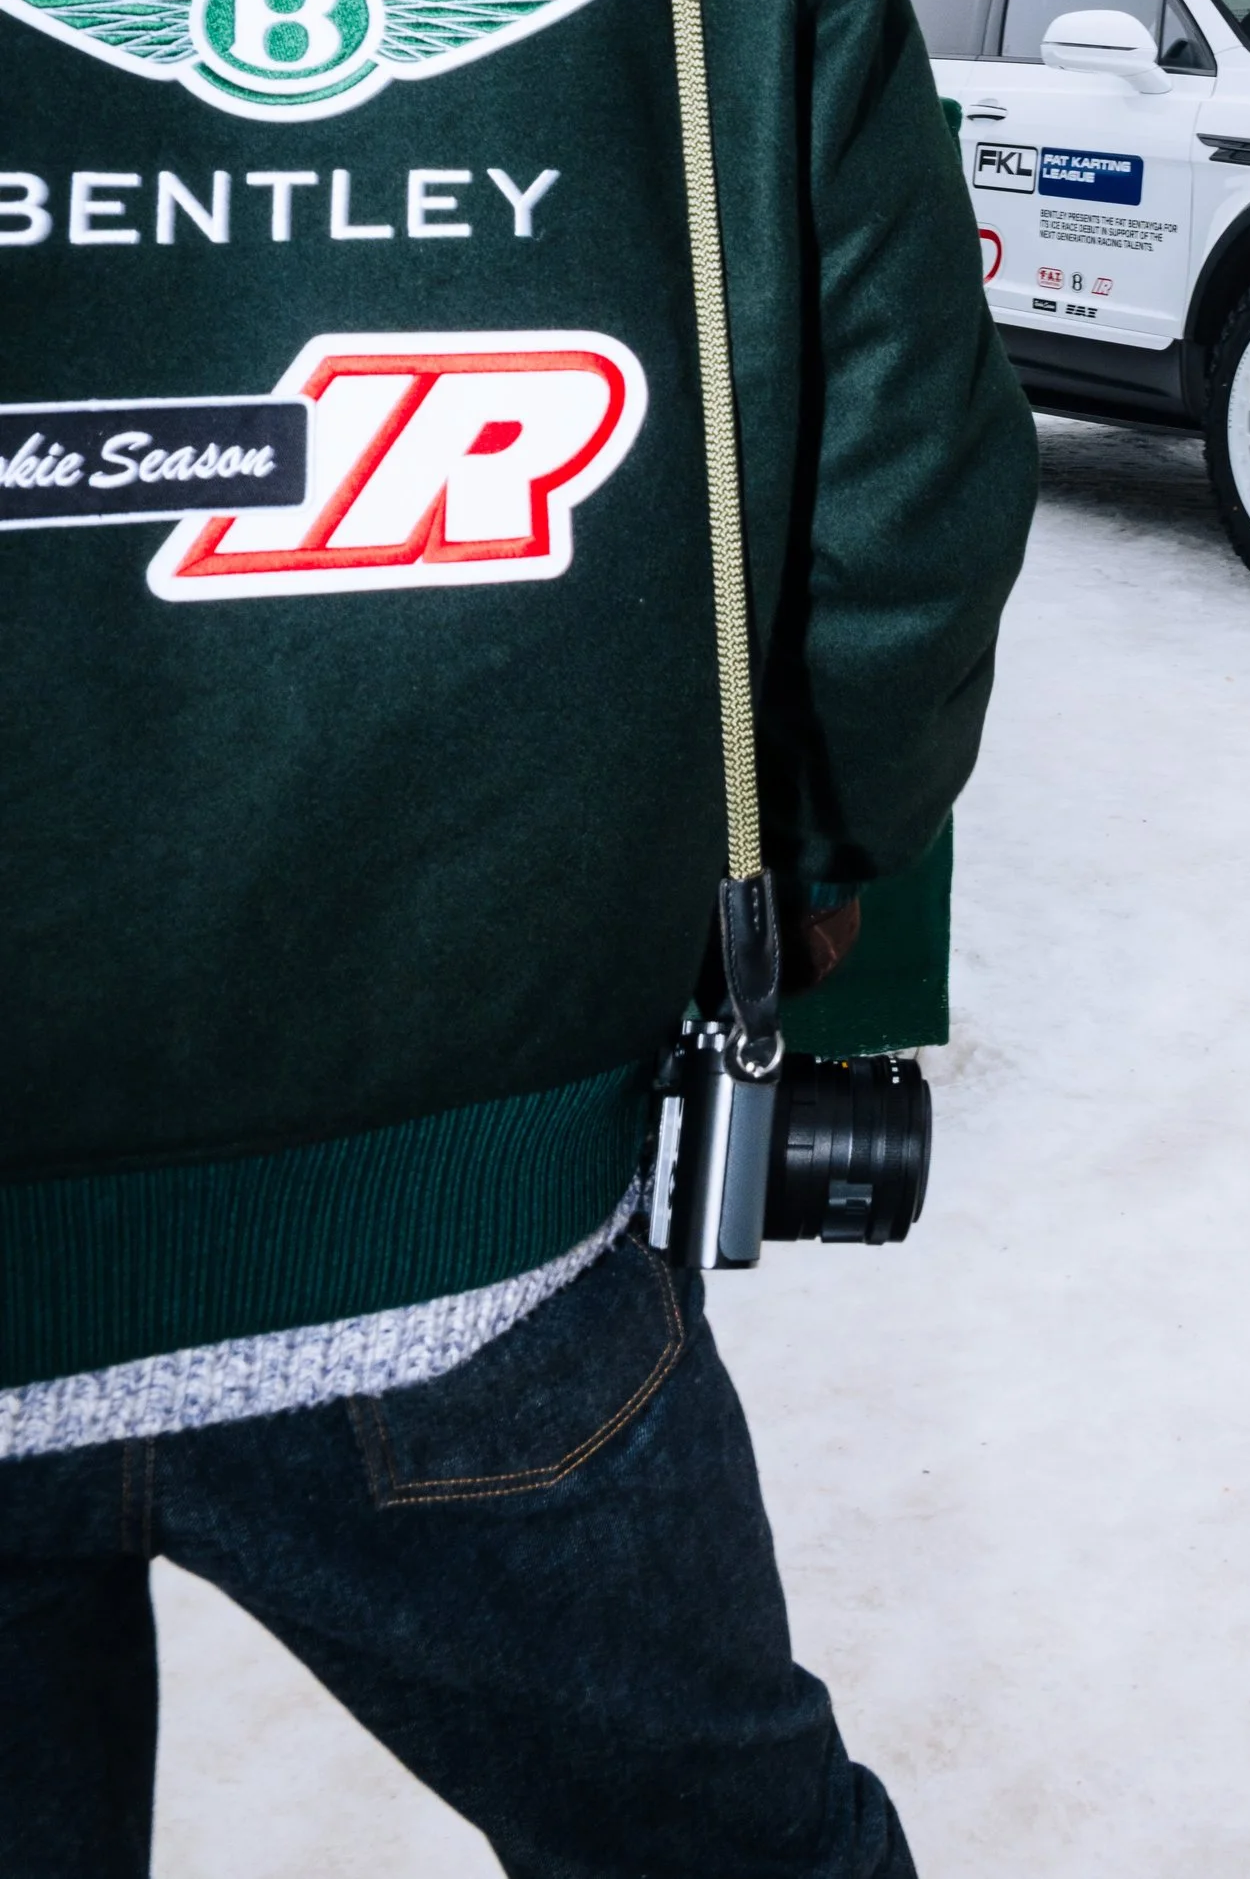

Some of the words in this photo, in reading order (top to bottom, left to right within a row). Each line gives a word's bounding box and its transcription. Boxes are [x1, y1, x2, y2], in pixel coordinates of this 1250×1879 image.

[978, 149, 1033, 176] FKL
[1042, 168, 1095, 183] LEAGUE
[1071, 157, 1131, 172] KARTING
[0, 168, 561, 246] BENTLEY
[0, 432, 85, 489] kie
[89, 431, 276, 488] Season
